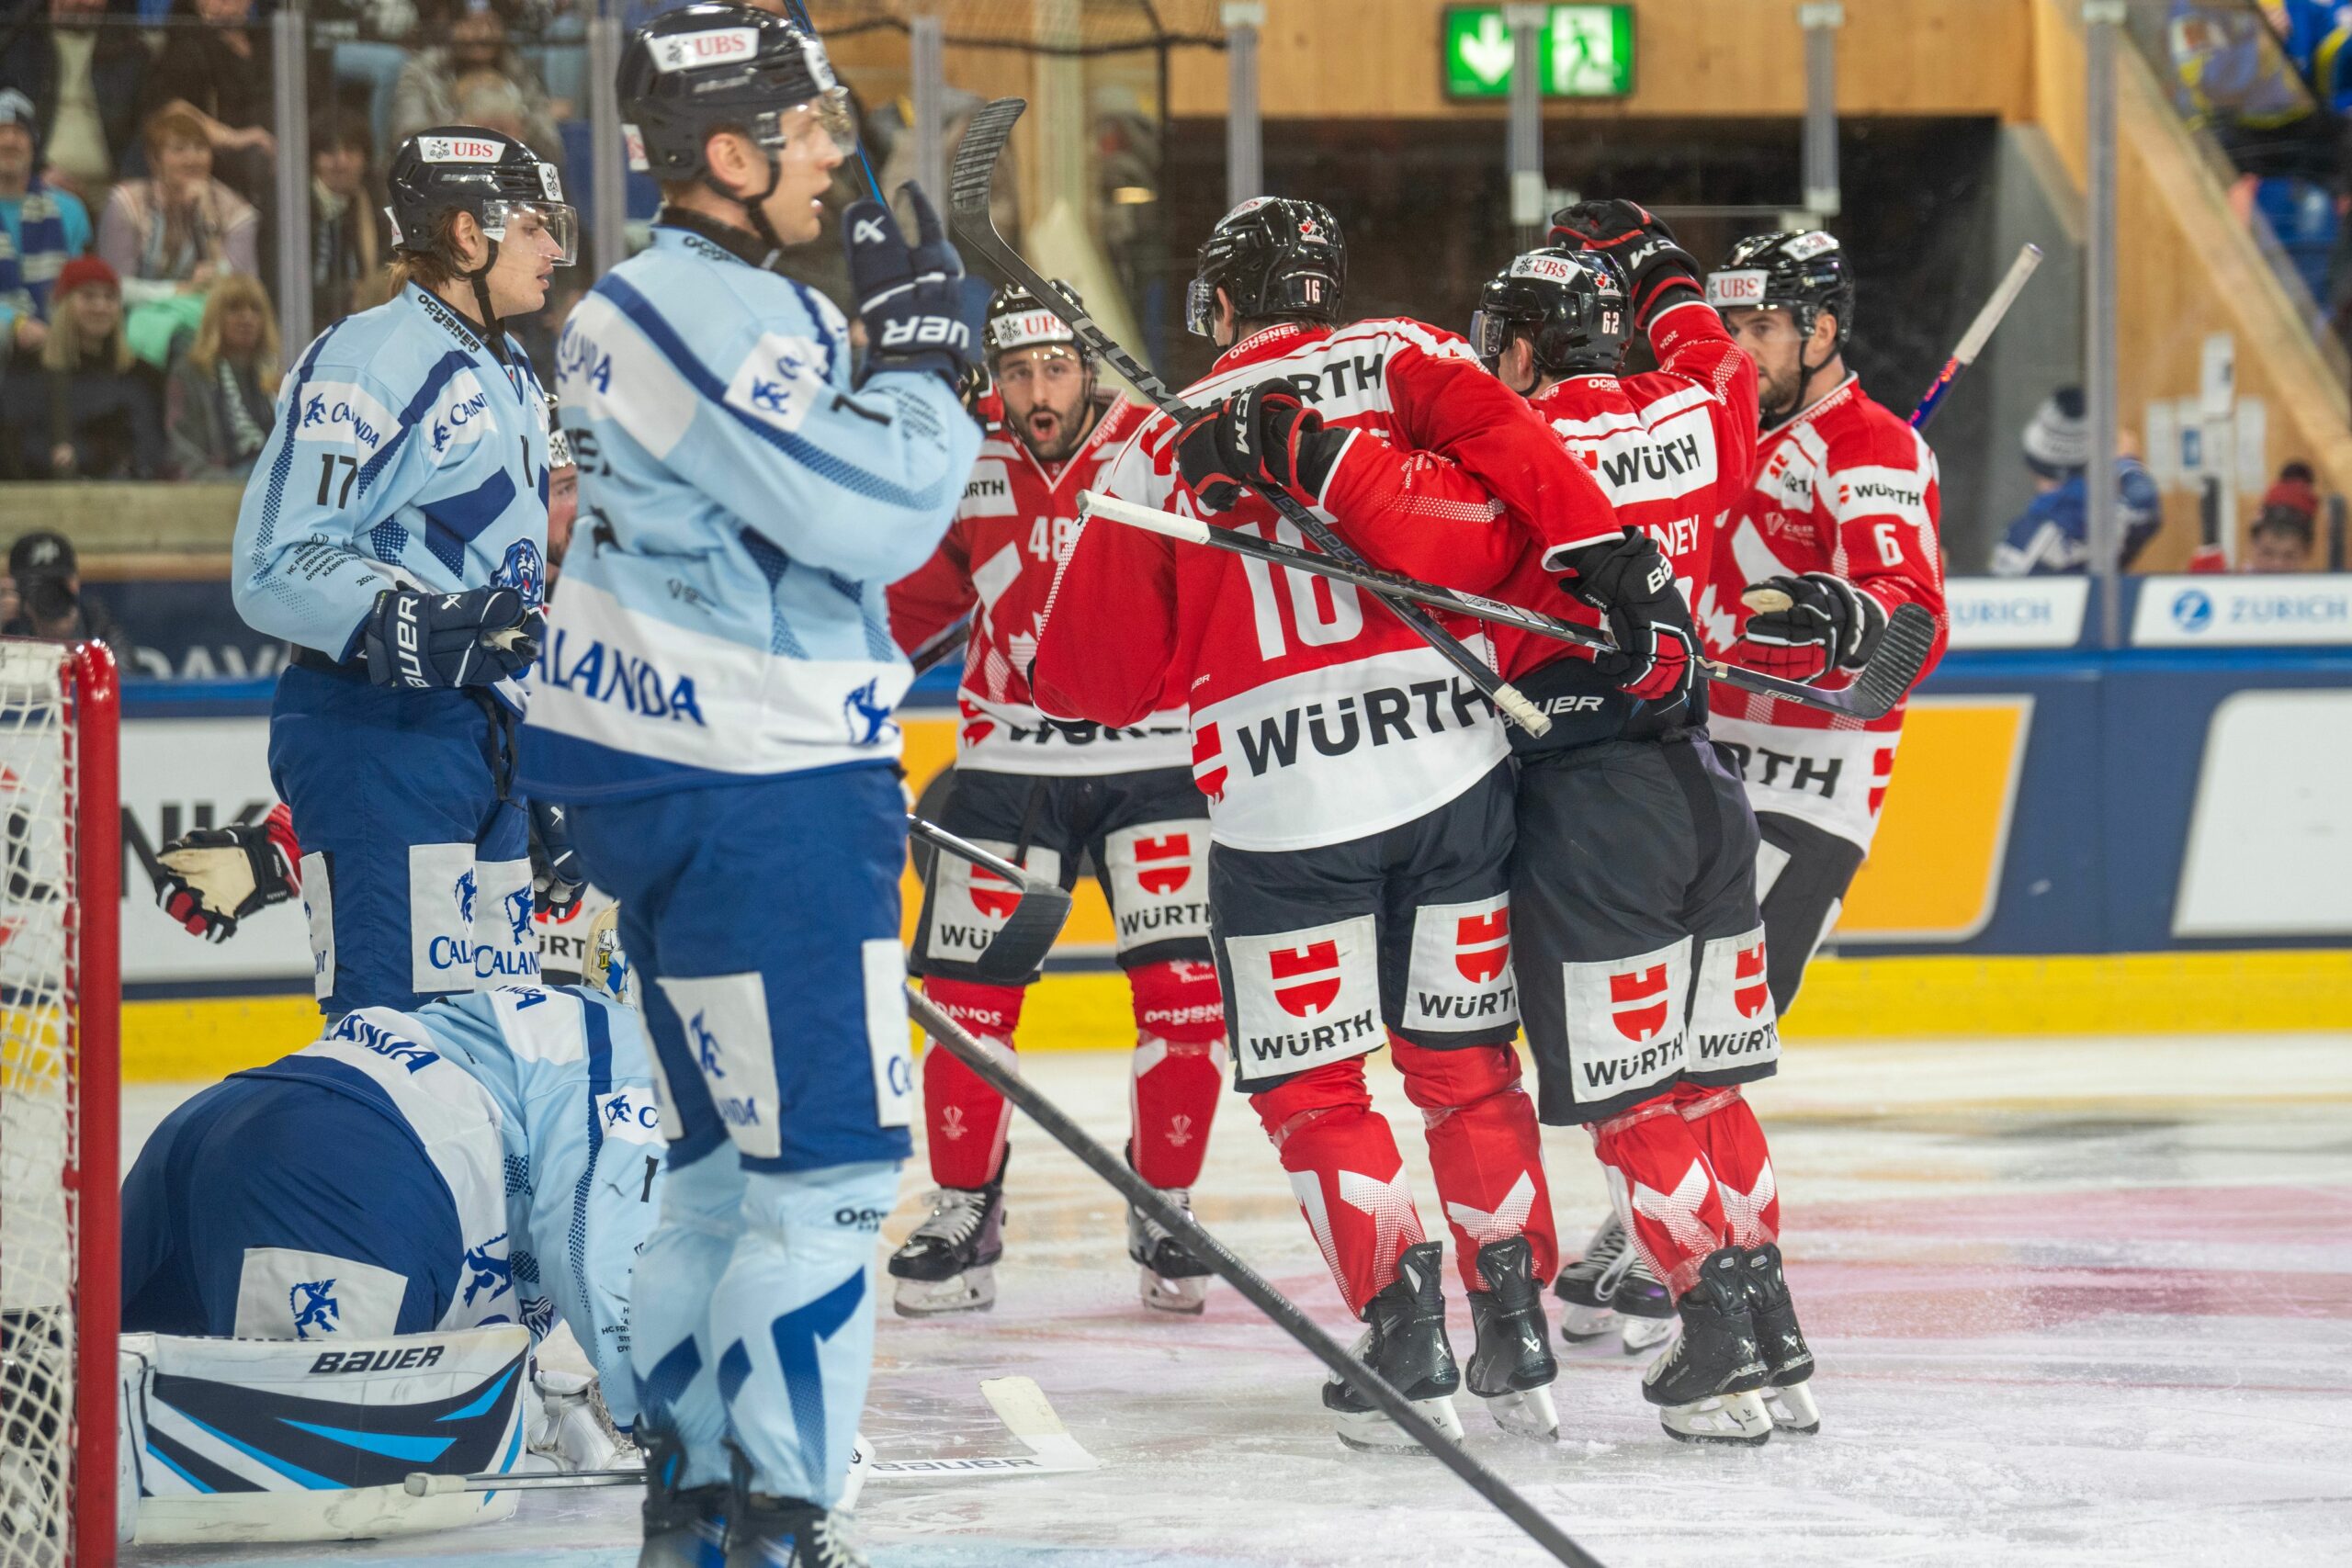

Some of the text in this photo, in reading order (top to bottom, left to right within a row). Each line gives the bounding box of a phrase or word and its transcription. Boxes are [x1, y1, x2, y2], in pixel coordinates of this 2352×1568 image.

[695, 35, 745, 56] UBS
[454, 142, 493, 157] UBS
[1533, 260, 1568, 278] UBS
[1305, 279, 1320, 304] 16
[1720, 278, 1759, 298] UBS
[418, 294, 481, 353] OCHSNER
[1601, 311, 1620, 334] 62
[1229, 325, 1300, 359] OCHSNER
[317, 454, 357, 510] 17
[1855, 483, 1920, 506] WÜRTH
[1028, 516, 1074, 562] 48
[1638, 514, 1699, 557] NEY
[1874, 524, 1904, 567] 6
[2233, 595, 2348, 623] ZURICH
[1767, 692, 1802, 703] CCM
[1237, 676, 1496, 778] WÜRTH
[1250, 1009, 1375, 1061] WÜRTH
[1584, 1031, 1684, 1088] WÜRTH
[309, 1345, 446, 1374] BAUER
[871, 1458, 1045, 1472] BAUER
